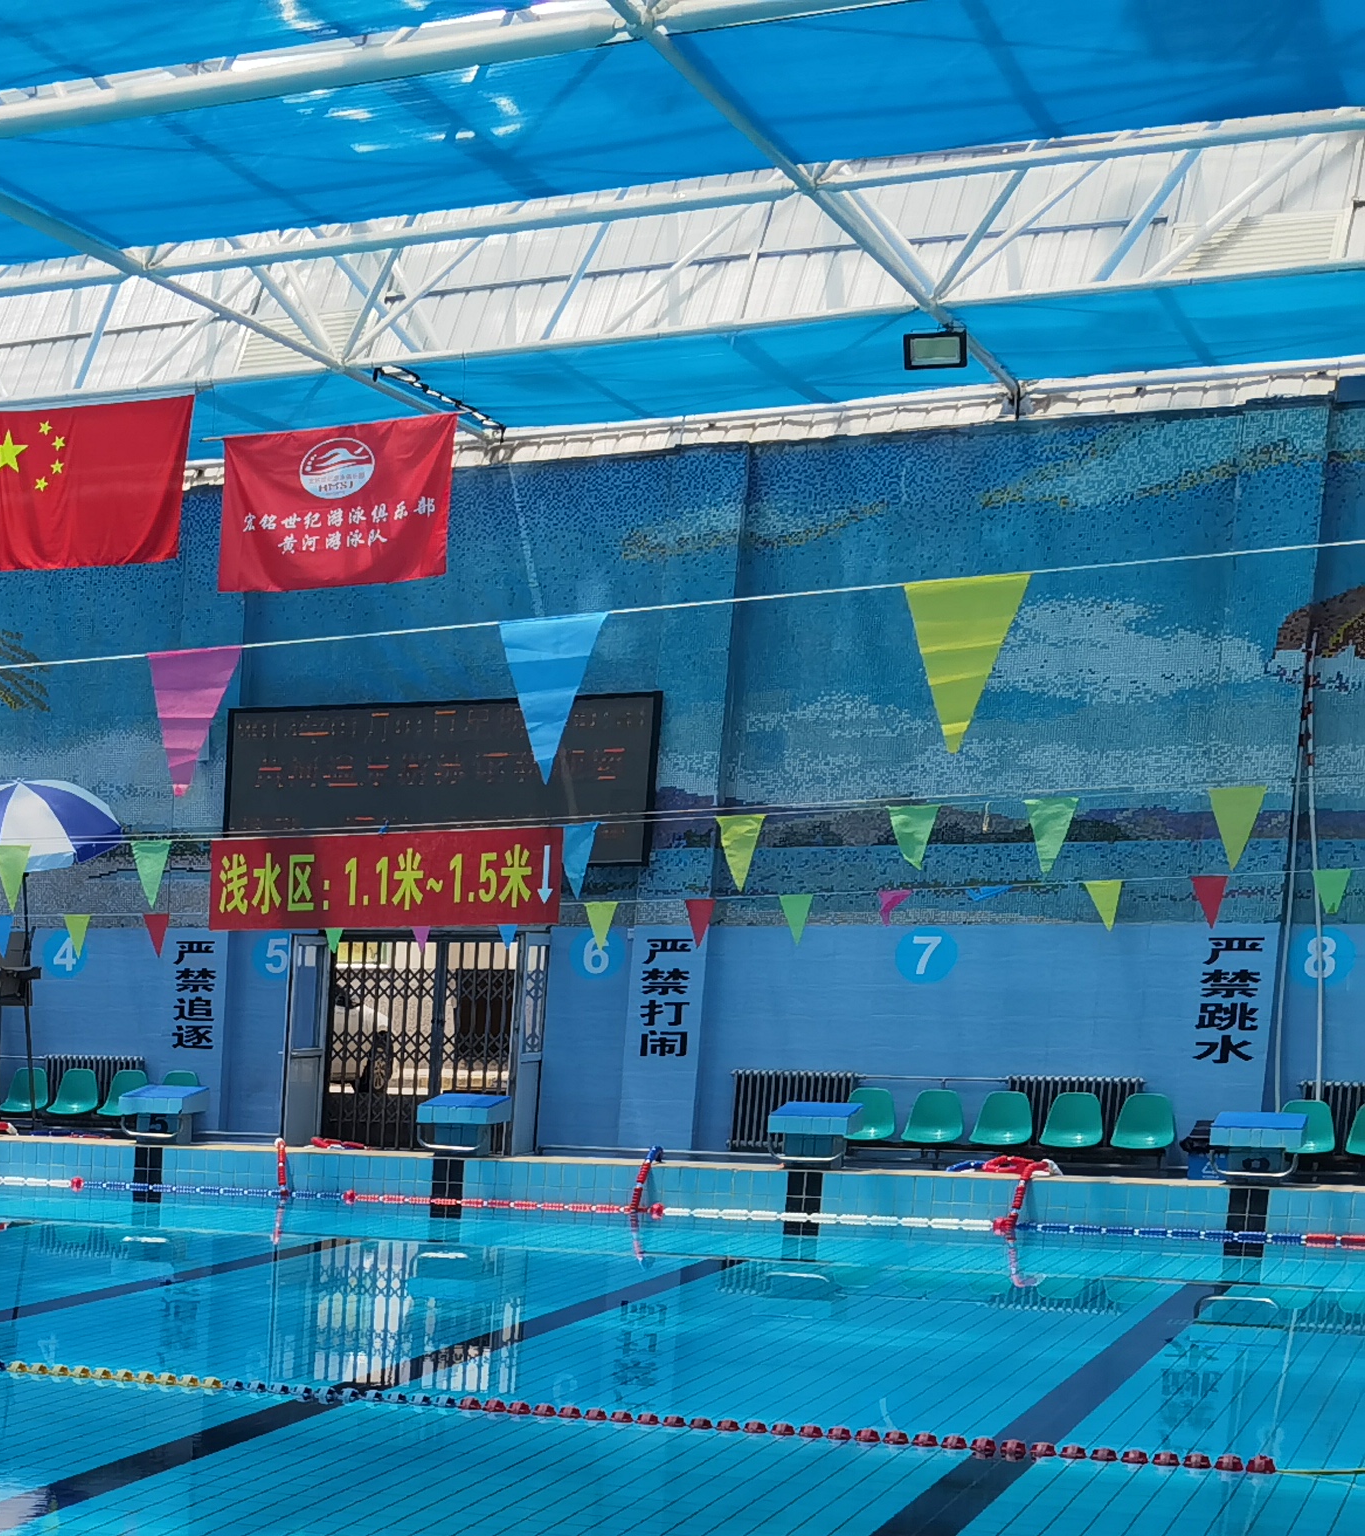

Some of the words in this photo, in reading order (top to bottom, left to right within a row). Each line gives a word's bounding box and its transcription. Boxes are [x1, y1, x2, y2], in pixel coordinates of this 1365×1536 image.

[243, 497, 435, 532] 宏铭世纪游泳俱乐部
[278, 529, 387, 555] 黄河游泳队
[219, 844, 531, 915] 浅水区：1.1米~1.5米
[53, 937, 77, 972] 4
[265, 938, 288, 974] 5
[583, 937, 609, 974] 6
[913, 936, 942, 974] 7
[1304, 936, 1336, 979] 8
[172, 941, 216, 1050] 严禁追逐
[639, 938, 693, 1057] 严禁打闹
[1192, 937, 1265, 1064] 严禁跳水
